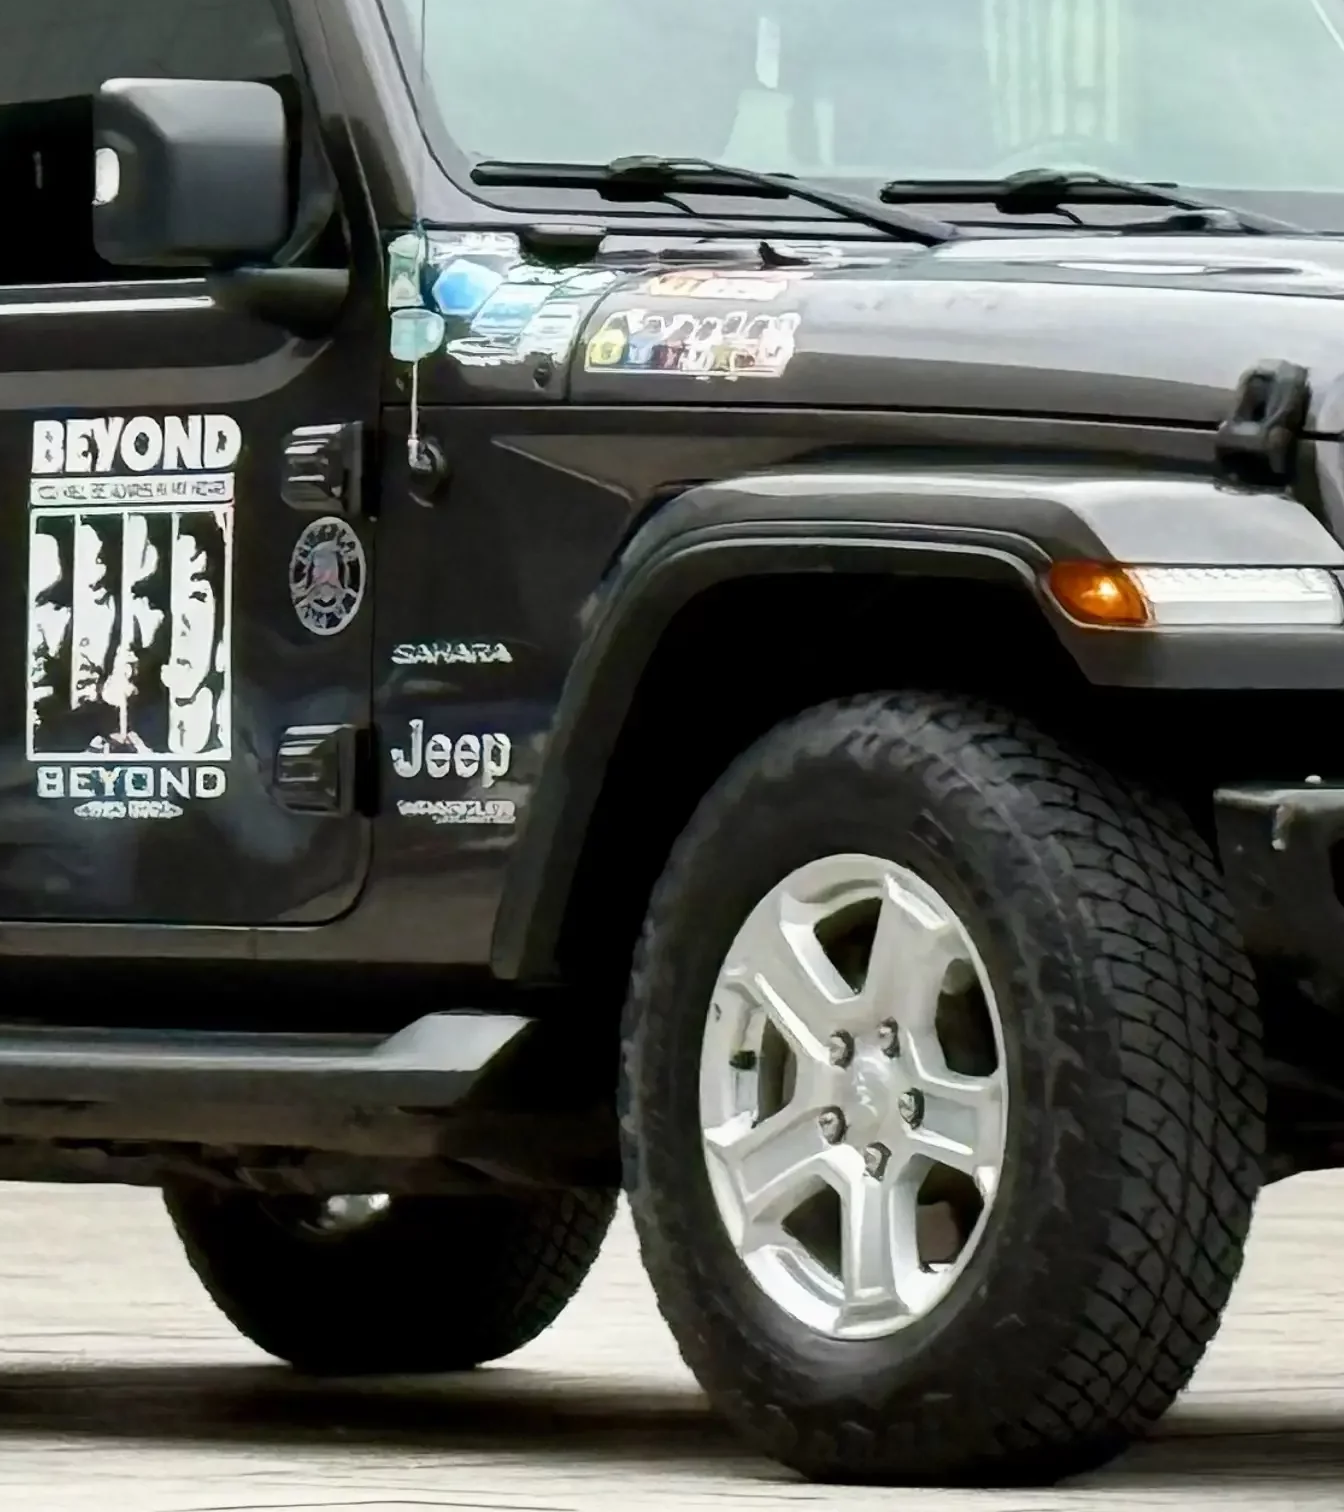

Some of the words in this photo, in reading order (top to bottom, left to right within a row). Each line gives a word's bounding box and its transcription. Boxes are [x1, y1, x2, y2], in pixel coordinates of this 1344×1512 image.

[31, 414, 242, 474] BEYOND
[391, 642, 513, 665] SAHARA
[390, 718, 512, 788] Jeep
[36, 766, 226, 800] BEYOND
